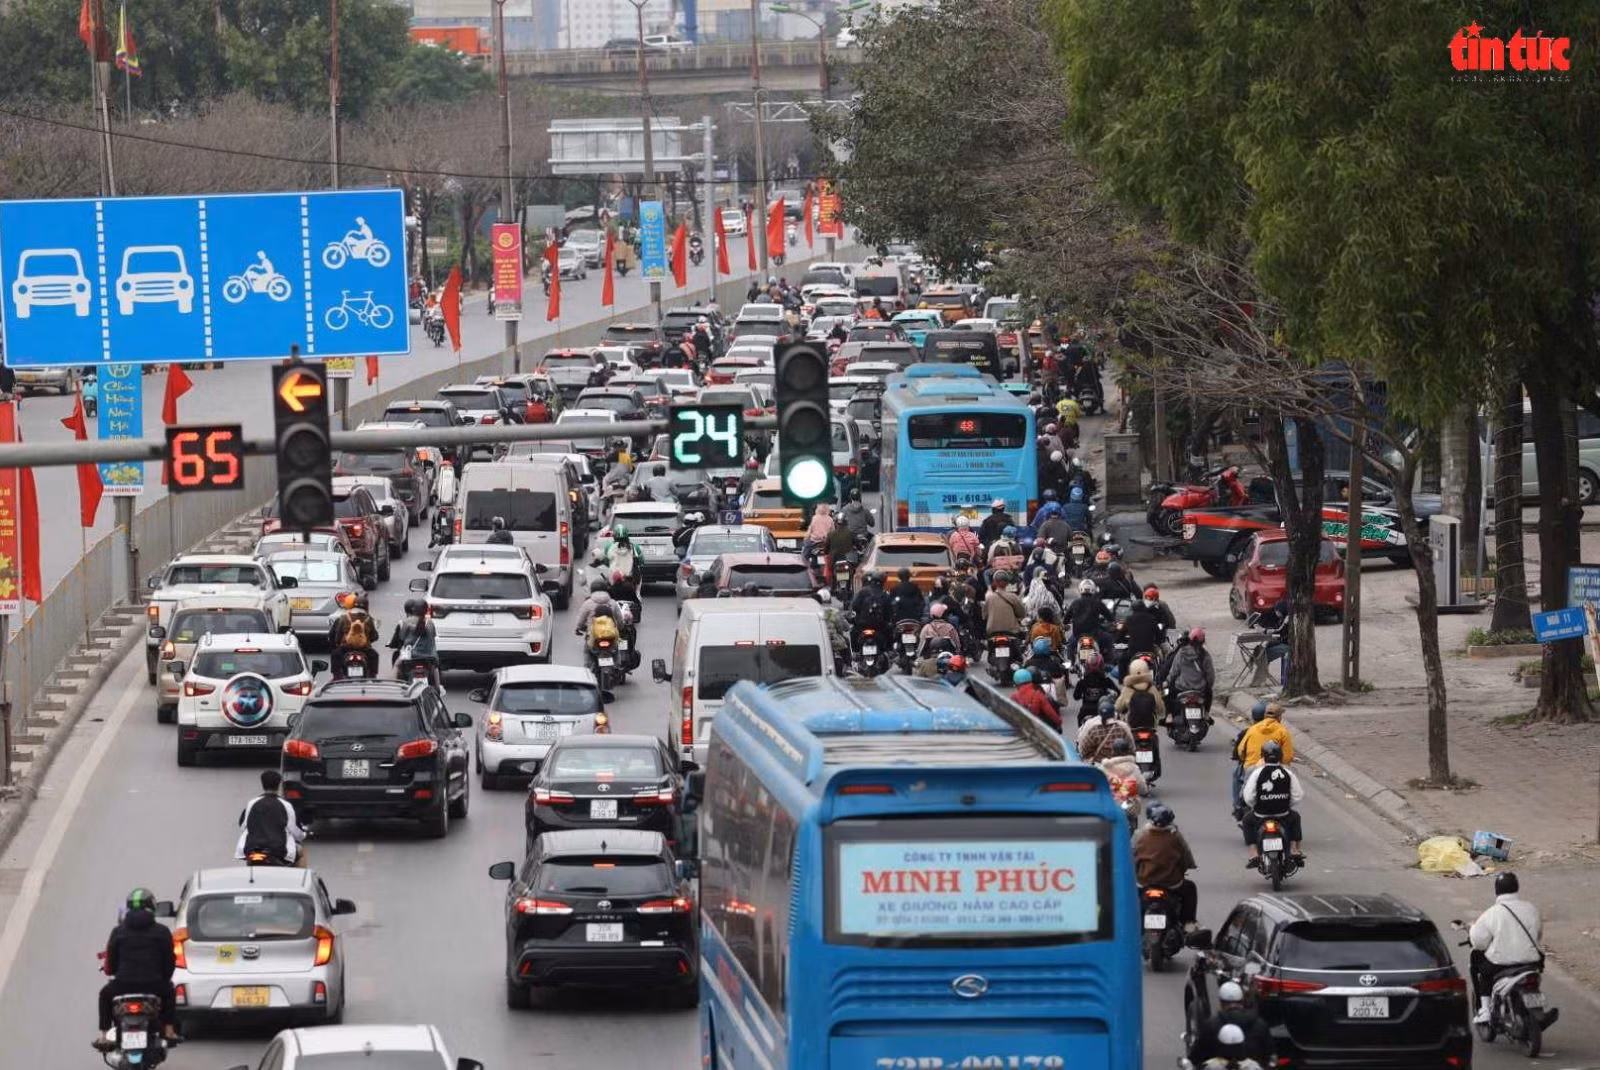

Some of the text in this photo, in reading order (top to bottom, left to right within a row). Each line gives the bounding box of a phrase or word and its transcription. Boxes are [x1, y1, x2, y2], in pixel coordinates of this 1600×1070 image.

[673, 410, 738, 465] 24
[171, 430, 242, 487] 65
[903, 850, 936, 863] CÔNG
[938, 852, 951, 862] TY
[955, 851, 986, 862] TNHH
[861, 861, 1076, 894] MINH PHÚC
[878, 901, 897, 912] XE
[998, 900, 1030, 911] CAO
